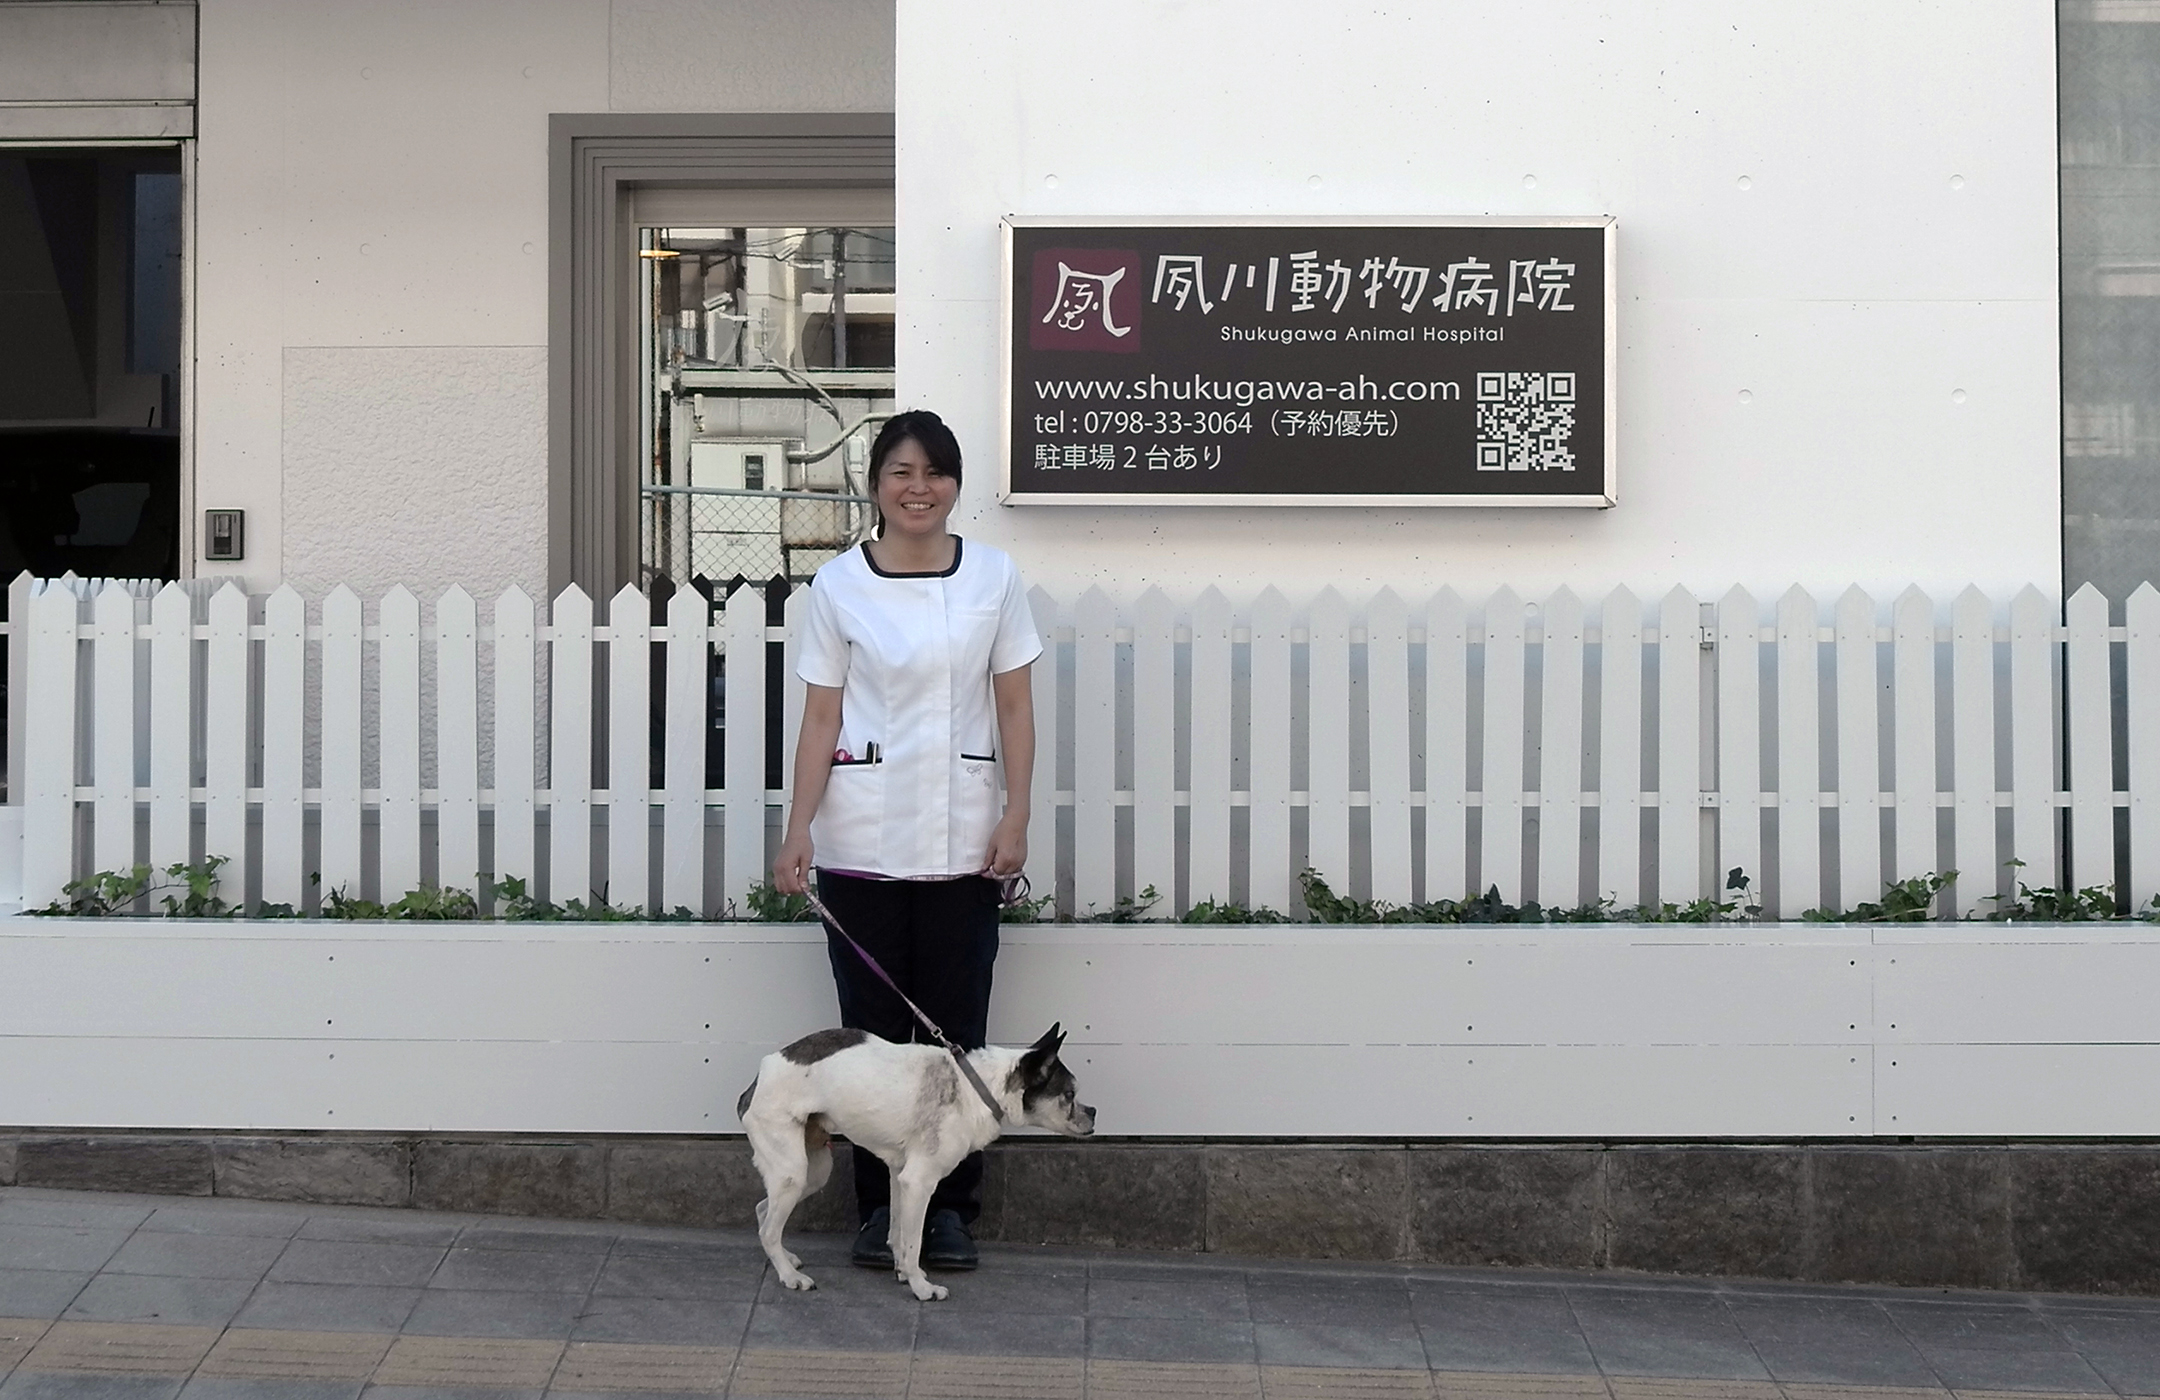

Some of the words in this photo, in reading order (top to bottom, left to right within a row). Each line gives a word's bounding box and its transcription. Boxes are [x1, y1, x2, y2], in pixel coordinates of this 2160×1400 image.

[1152, 251, 1576, 316] 夙川動物病院
[1221, 326, 1337, 345] Shukugawa
[1345, 326, 1415, 342] Animal
[1423, 326, 1504, 345] Hospital
[1034, 374, 1460, 406] www.shukugawa-ah.com
[1084, 411, 1252, 434] 0798-33-3064
